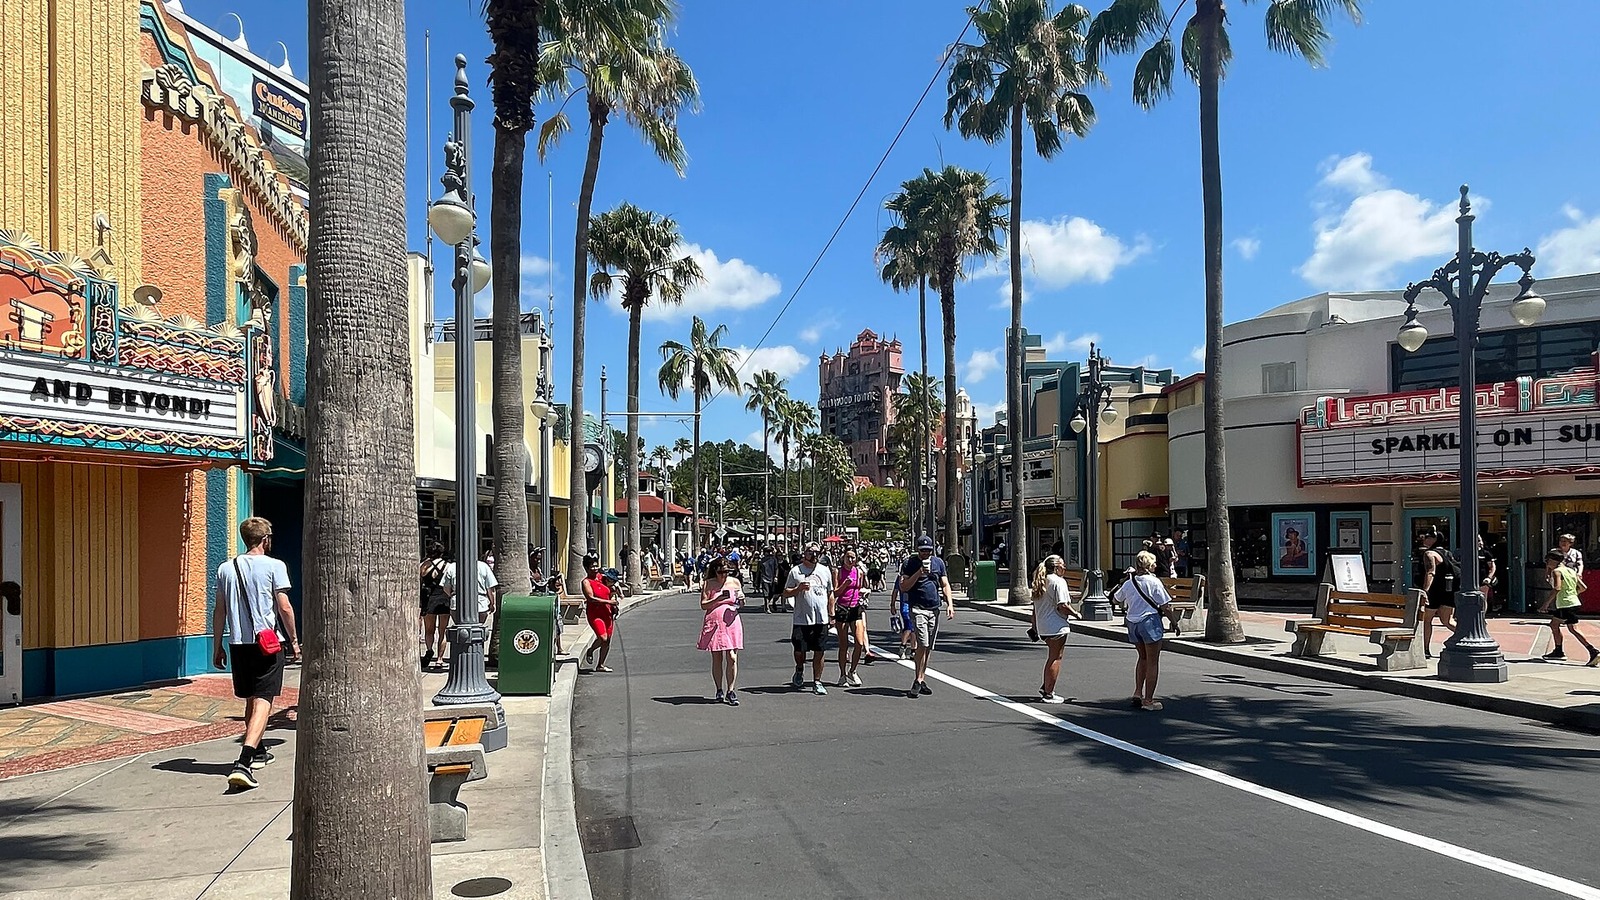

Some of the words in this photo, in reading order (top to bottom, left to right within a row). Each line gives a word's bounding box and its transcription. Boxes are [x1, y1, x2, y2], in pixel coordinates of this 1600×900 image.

[255, 82, 304, 121] Cuties
[258, 100, 302, 131] MANDARINS
[32, 377, 93, 401] AND
[108, 387, 211, 416] BEYOND!
[1371, 431, 1481, 456] SPARKL
[1493, 427, 1532, 447] ON
[1029, 460, 1042, 470] THE
